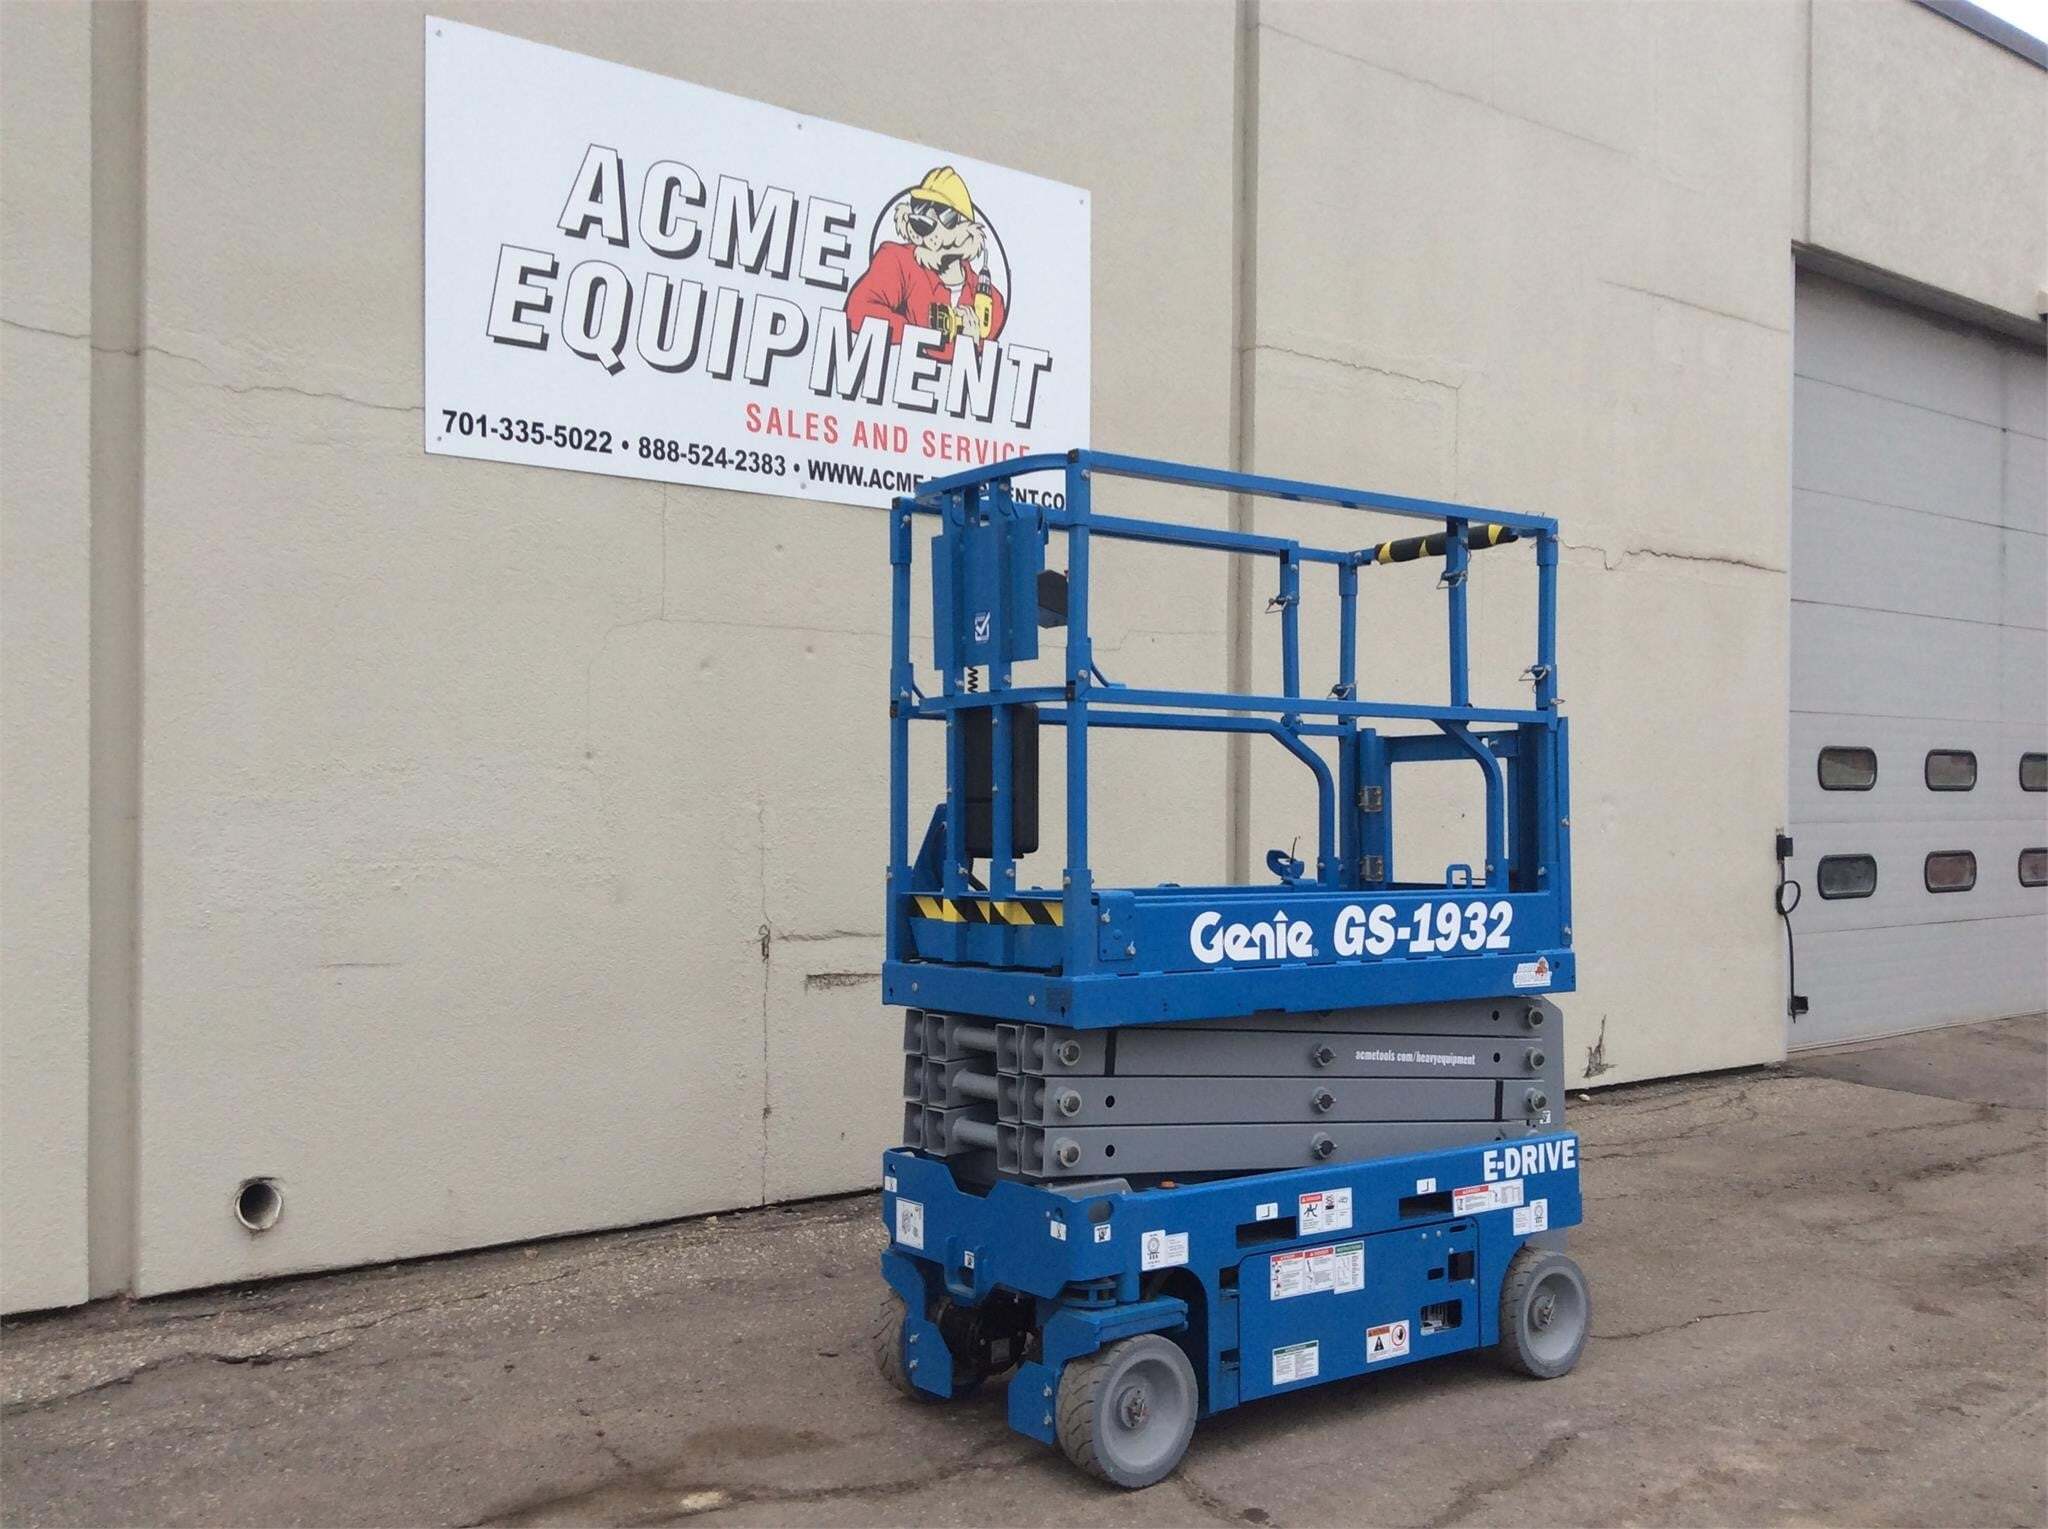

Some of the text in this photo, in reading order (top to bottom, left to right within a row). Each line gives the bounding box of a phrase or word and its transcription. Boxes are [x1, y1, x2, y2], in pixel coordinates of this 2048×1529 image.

[557, 143, 856, 292] ACME
[486, 243, 1054, 429] EQUIPMENT
[442, 409, 613, 454] 701-335-5022
[638, 436, 786, 476] 888-524-2383
[746, 403, 838, 444] SALES
[852, 420, 908, 453] AND
[1190, 900, 1514, 964] Genie GS-1932
[1483, 1139, 1576, 1181] E-DRIVE
